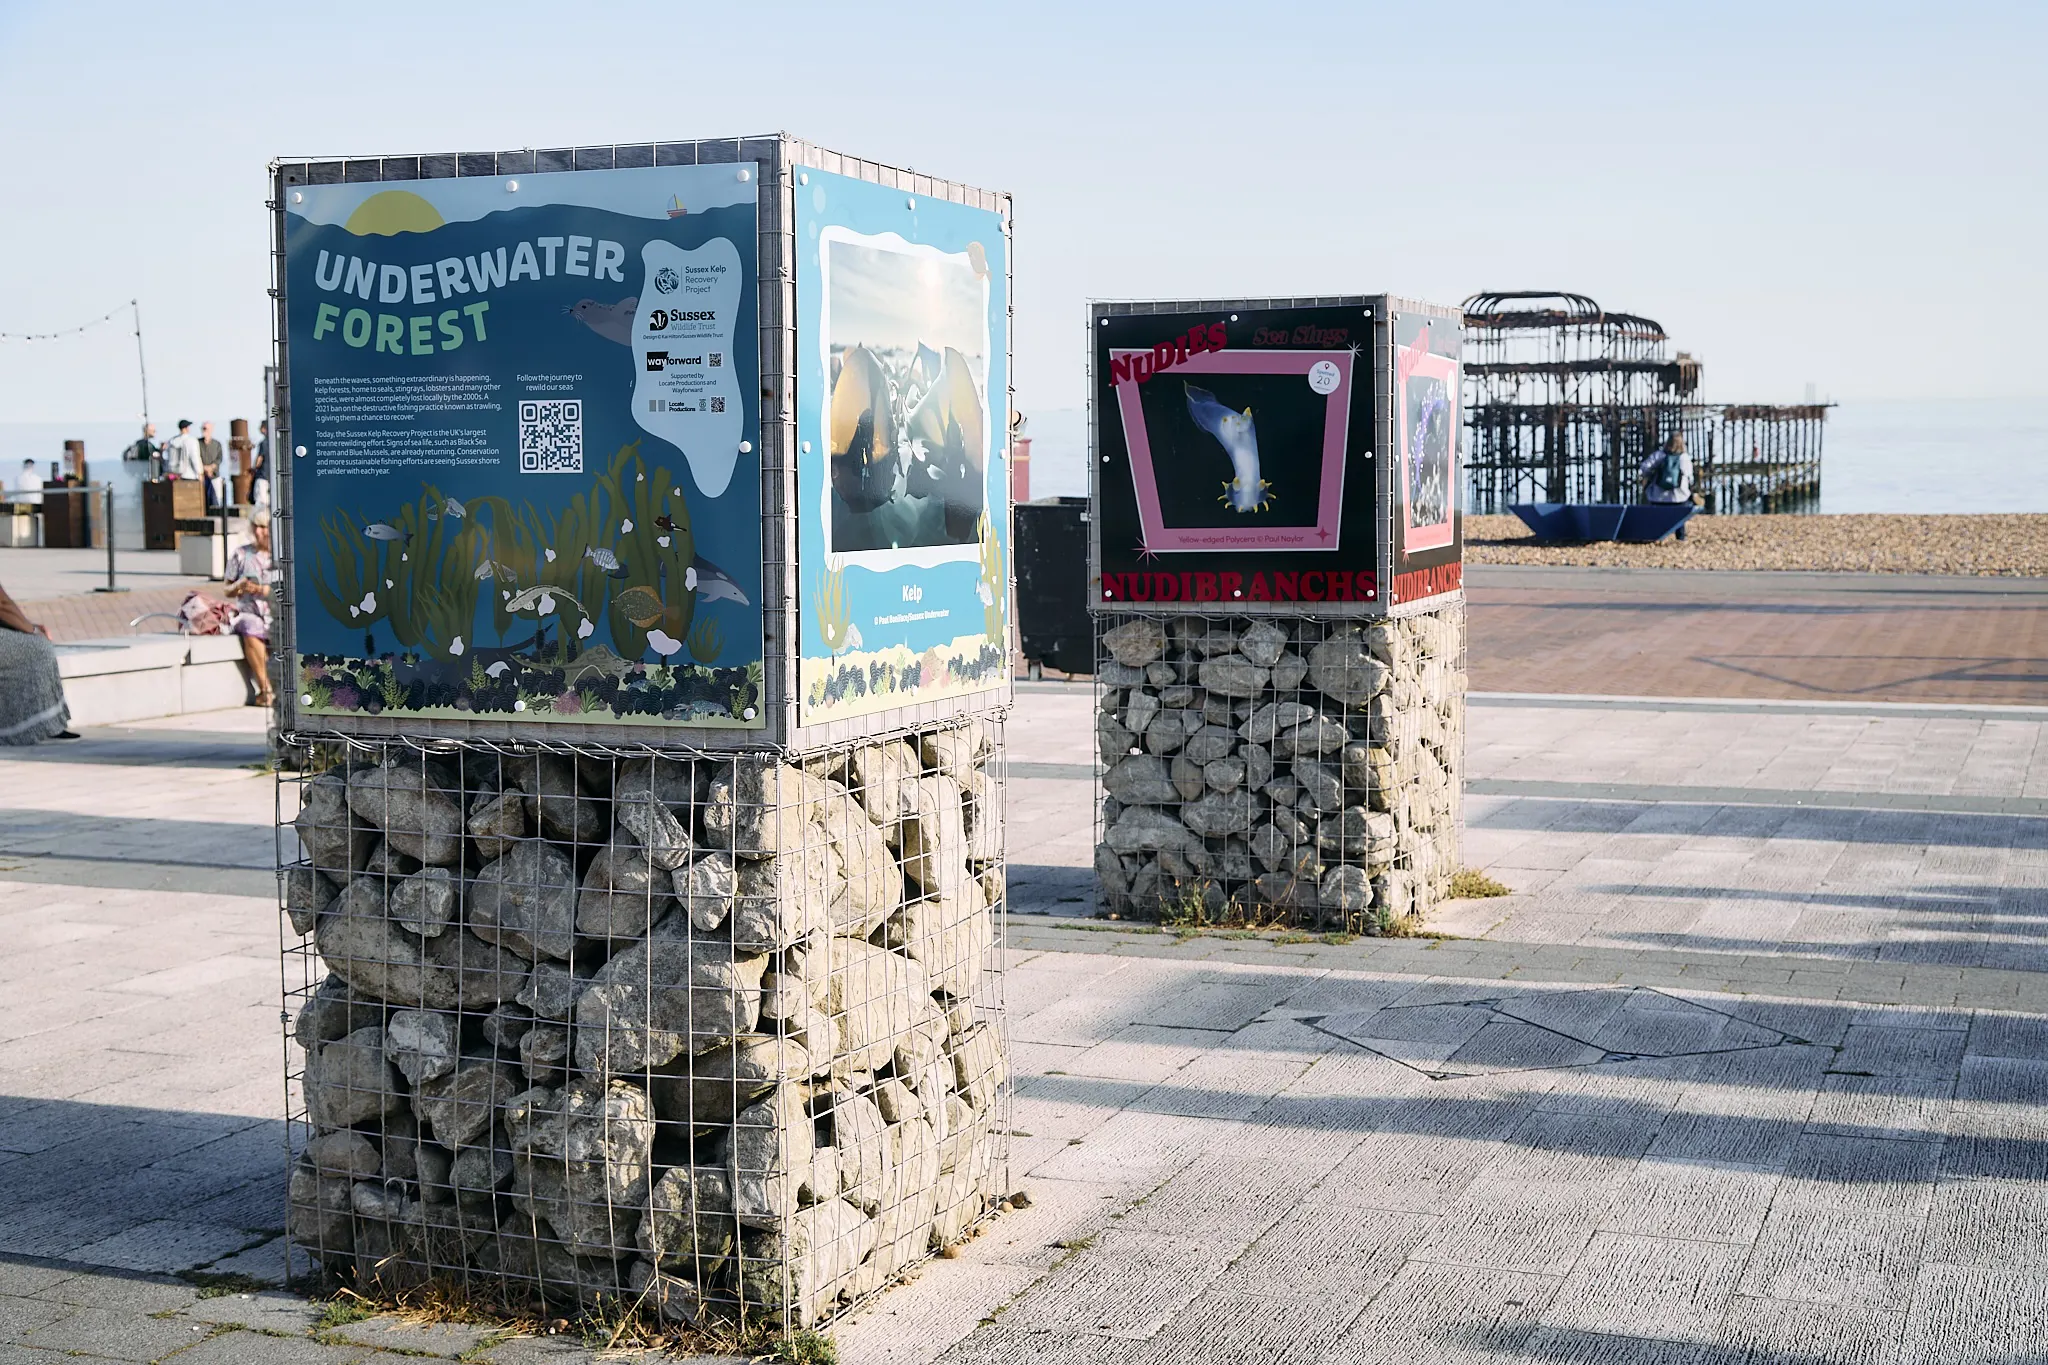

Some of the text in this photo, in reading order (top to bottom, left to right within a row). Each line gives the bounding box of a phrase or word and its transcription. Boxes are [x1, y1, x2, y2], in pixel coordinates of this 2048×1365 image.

[315, 235, 625, 304] UNDERWATER
[685, 265, 727, 275] Sussex Kelp
[685, 275, 719, 285] Recovery
[685, 286, 711, 295] Project
[670, 309, 716, 322] Sussex
[313, 301, 490, 355] FOREST
[670, 323, 716, 332] Wildlife Trust
[1109, 321, 1228, 386] NUDIES
[648, 355, 702, 368] wayforward
[372, 376, 406, 385] something
[406, 375, 448, 384] extraordinary
[455, 375, 492, 383] happening.
[516, 374, 538, 382] Follow
[549, 374, 576, 383] journey
[670, 372, 697, 380] Supported
[1316, 376, 1331, 386] 20
[525, 383, 546, 391] rewild
[676, 379, 707, 387] Productions
[314, 387, 328, 395] Kelp
[426, 384, 451, 392] lobsters
[452, 384, 464, 392] and
[465, 385, 483, 393] many
[671, 387, 703, 395] Wayforward
[376, 394, 411, 404] completely
[411, 394, 422, 402] lost
[423, 393, 443, 403] locally
[444, 393, 451, 403] by
[452, 393, 463, 401] the
[315, 405, 330, 413] 2021
[331, 404, 343, 412] ban
[352, 404, 362, 412] the
[397, 403, 419, 413] fishing
[419, 403, 444, 413] practice
[321, 414, 340, 424] giving
[336, 430, 346, 438] the
[346, 430, 368, 438] Sussex
[368, 430, 382, 439] Kelp
[382, 429, 410, 439] Recovery
[411, 429, 433, 439] Project
[433, 429, 439, 437] is
[439, 429, 450, 437] the
[464, 428, 487, 438] largest
[315, 439, 338, 447] marine
[338, 439, 367, 449] rewilding
[386, 438, 403, 448] Signs
[403, 438, 411, 446] of
[434, 438, 449, 446] such
[457, 438, 475, 446] Black
[316, 449, 337, 457] Bream
[337, 448, 348, 456] and
[349, 448, 363, 456] Blue
[401, 448, 425, 457] already
[457, 447, 500, 455] Conservation
[316, 458, 329, 466] and
[345, 458, 380, 466] sustainable
[381, 457, 402, 467] fishing
[402, 457, 423, 465] efforts
[434, 457, 456, 467] seeing
[456, 457, 478, 465] Sussex
[478, 456, 501, 465] shores
[316, 468, 328, 477] get
[328, 467, 346, 475] wilder
[346, 467, 360, 475] with
[360, 467, 375, 475] each
[1177, 535, 1225, 545] Yellow-edged
[1225, 535, 1256, 545] Polycera
[1264, 534, 1280, 543] Paul
[1280, 535, 1305, 544] Naylor
[1100, 571, 1378, 601] NUDIBRANCHS
[902, 584, 923, 604] Kelp
